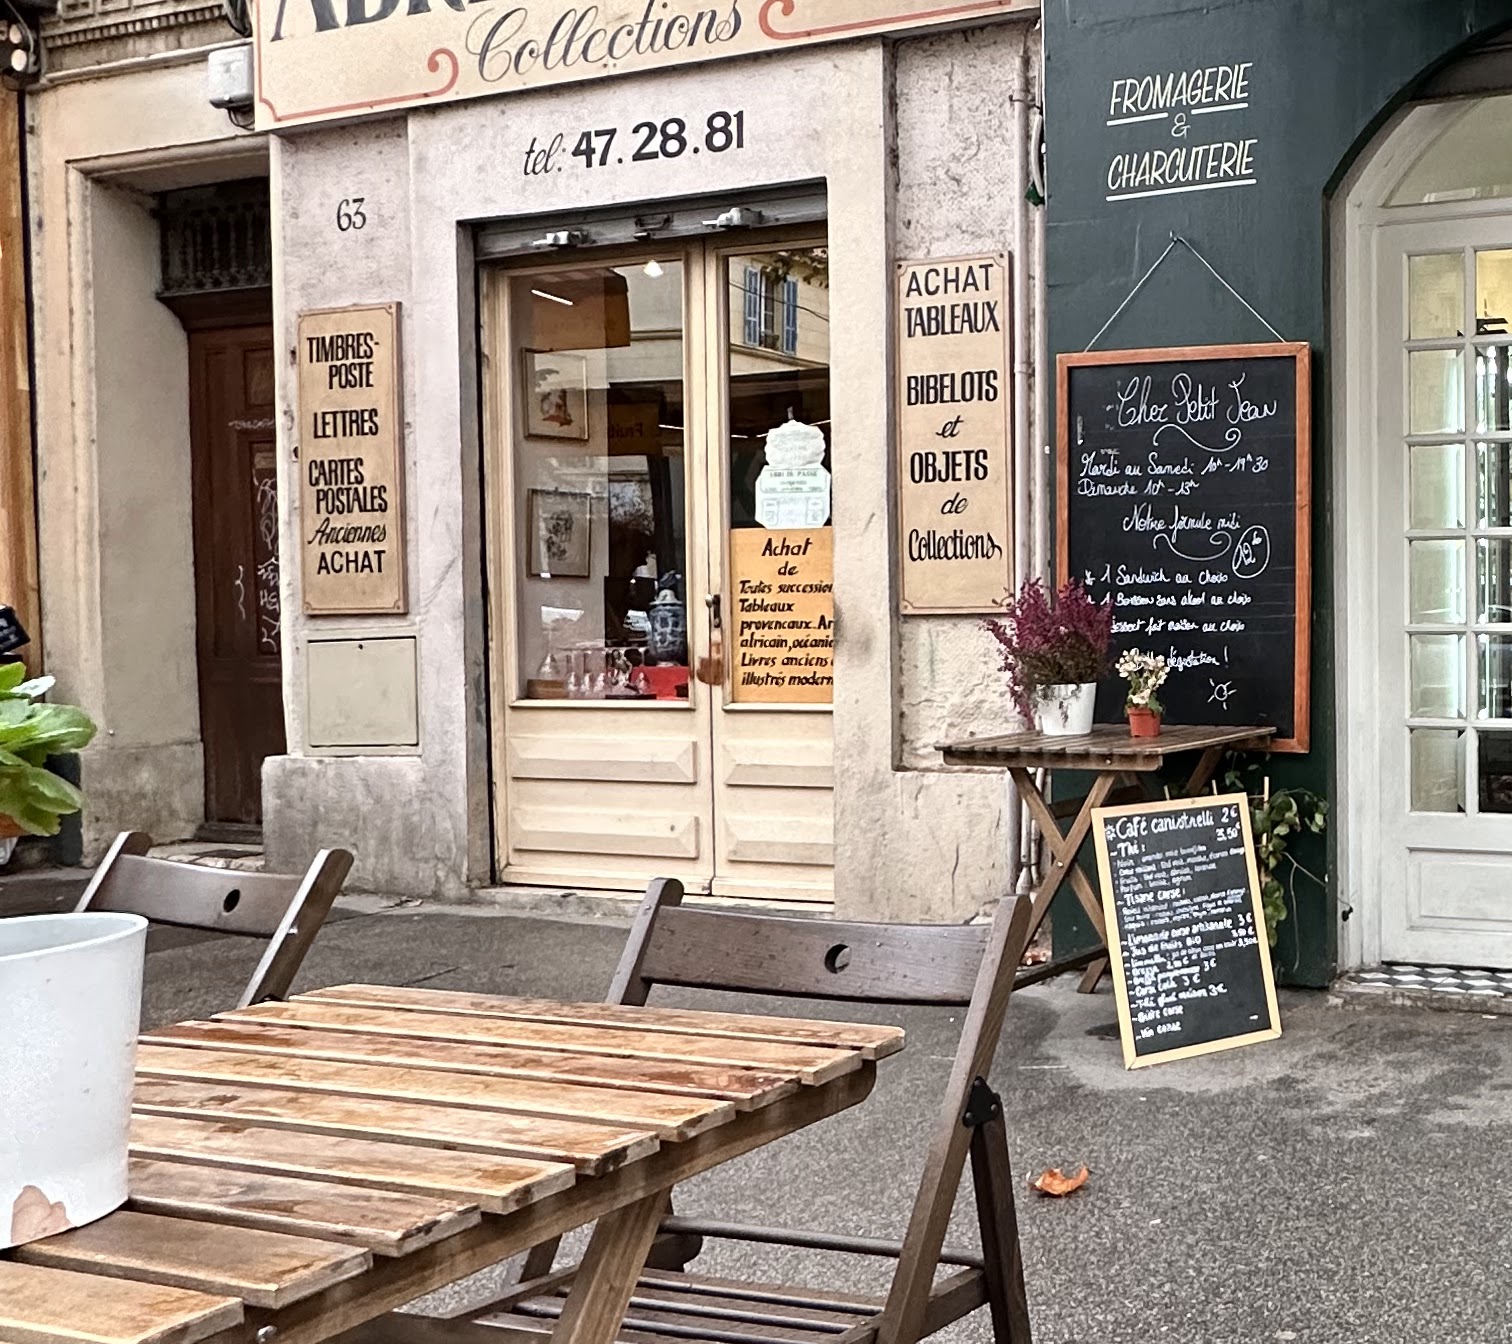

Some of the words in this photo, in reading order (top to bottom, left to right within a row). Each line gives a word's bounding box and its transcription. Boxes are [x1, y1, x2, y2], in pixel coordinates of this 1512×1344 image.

[1108, 62, 1252, 119] FROMAGERIE
[1173, 112, 1191, 136] &
[1106, 138, 1256, 189] CHARCUTERIE
[336, 198, 366, 232] 63
[905, 263, 994, 298] ACHAT
[905, 301, 1000, 339] TABLEAUX
[307, 333, 379, 363] TIMBRES-
[328, 362, 374, 389] POSTE
[906, 370, 998, 406] BIBELOTS
[1172, 373, 1219, 424] Petit
[1227, 373, 1277, 424] Jean
[313, 408, 378, 438] LETTRES
[935, 415, 964, 438] et
[309, 458, 364, 487] CARTES
[910, 449, 988, 484] OBJETS
[1080, 451, 1121, 477] Mardi
[1125, 464, 1143, 476] au
[1147, 452, 1194, 476] Samedi
[316, 486, 388, 514] POSTALES
[1077, 478, 1138, 496] Dimanche
[941, 492, 968, 515] de
[307, 518, 387, 545] Anciennes
[1123, 503, 1167, 532] Notre
[1169, 505, 1212, 543] formule
[1217, 512, 1241, 530] midi
[761, 537, 813, 557] Achat
[908, 528, 1002, 562] Collections
[317, 550, 386, 575] ACHAT
[777, 561, 799, 576] de
[1116, 565, 1171, 585] Sandwich
[739, 580, 772, 594] Toutes
[739, 598, 795, 613] Tableaux
[741, 652, 777, 667] Livres
[781, 653, 829, 667] anciens
[741, 671, 786, 687] illustrés
[1115, 816, 1148, 840] Café
